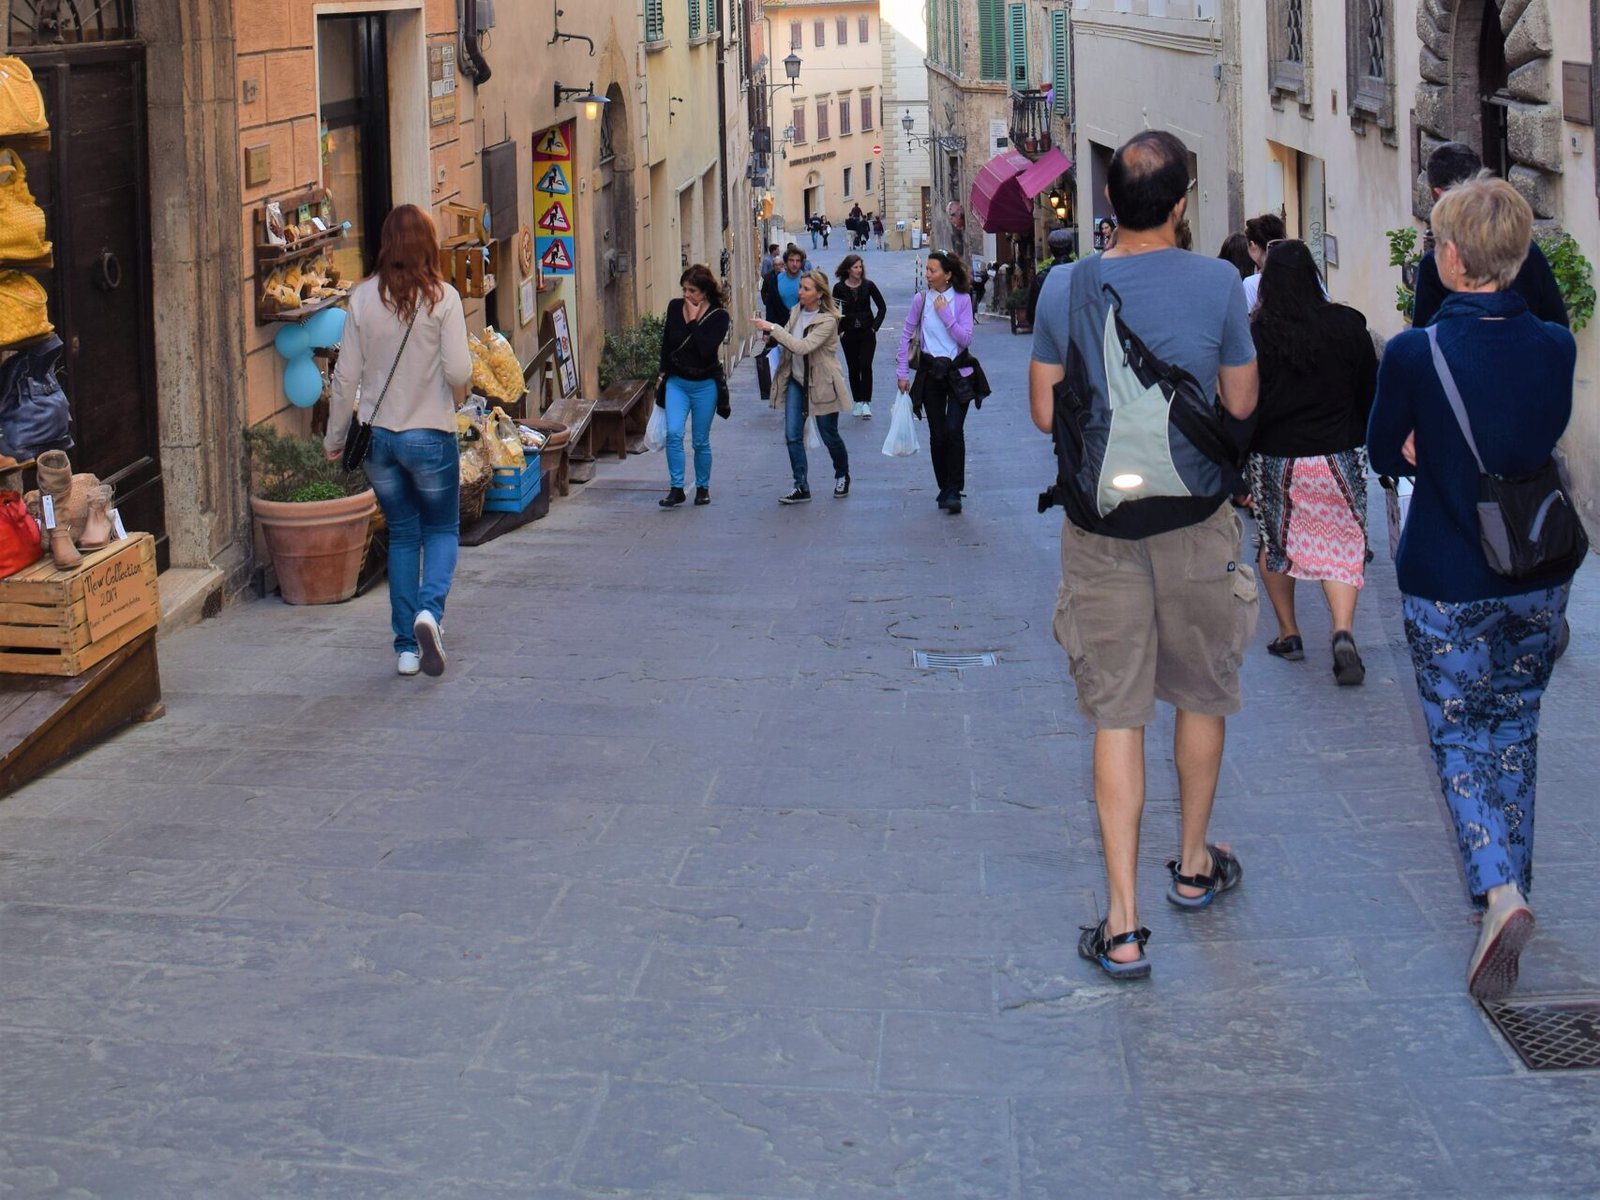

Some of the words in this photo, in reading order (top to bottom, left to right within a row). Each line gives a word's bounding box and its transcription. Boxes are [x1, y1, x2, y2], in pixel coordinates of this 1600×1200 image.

[84, 571, 103, 596] New
[106, 561, 142, 586] Collection
[100, 587, 118, 607] 2017
